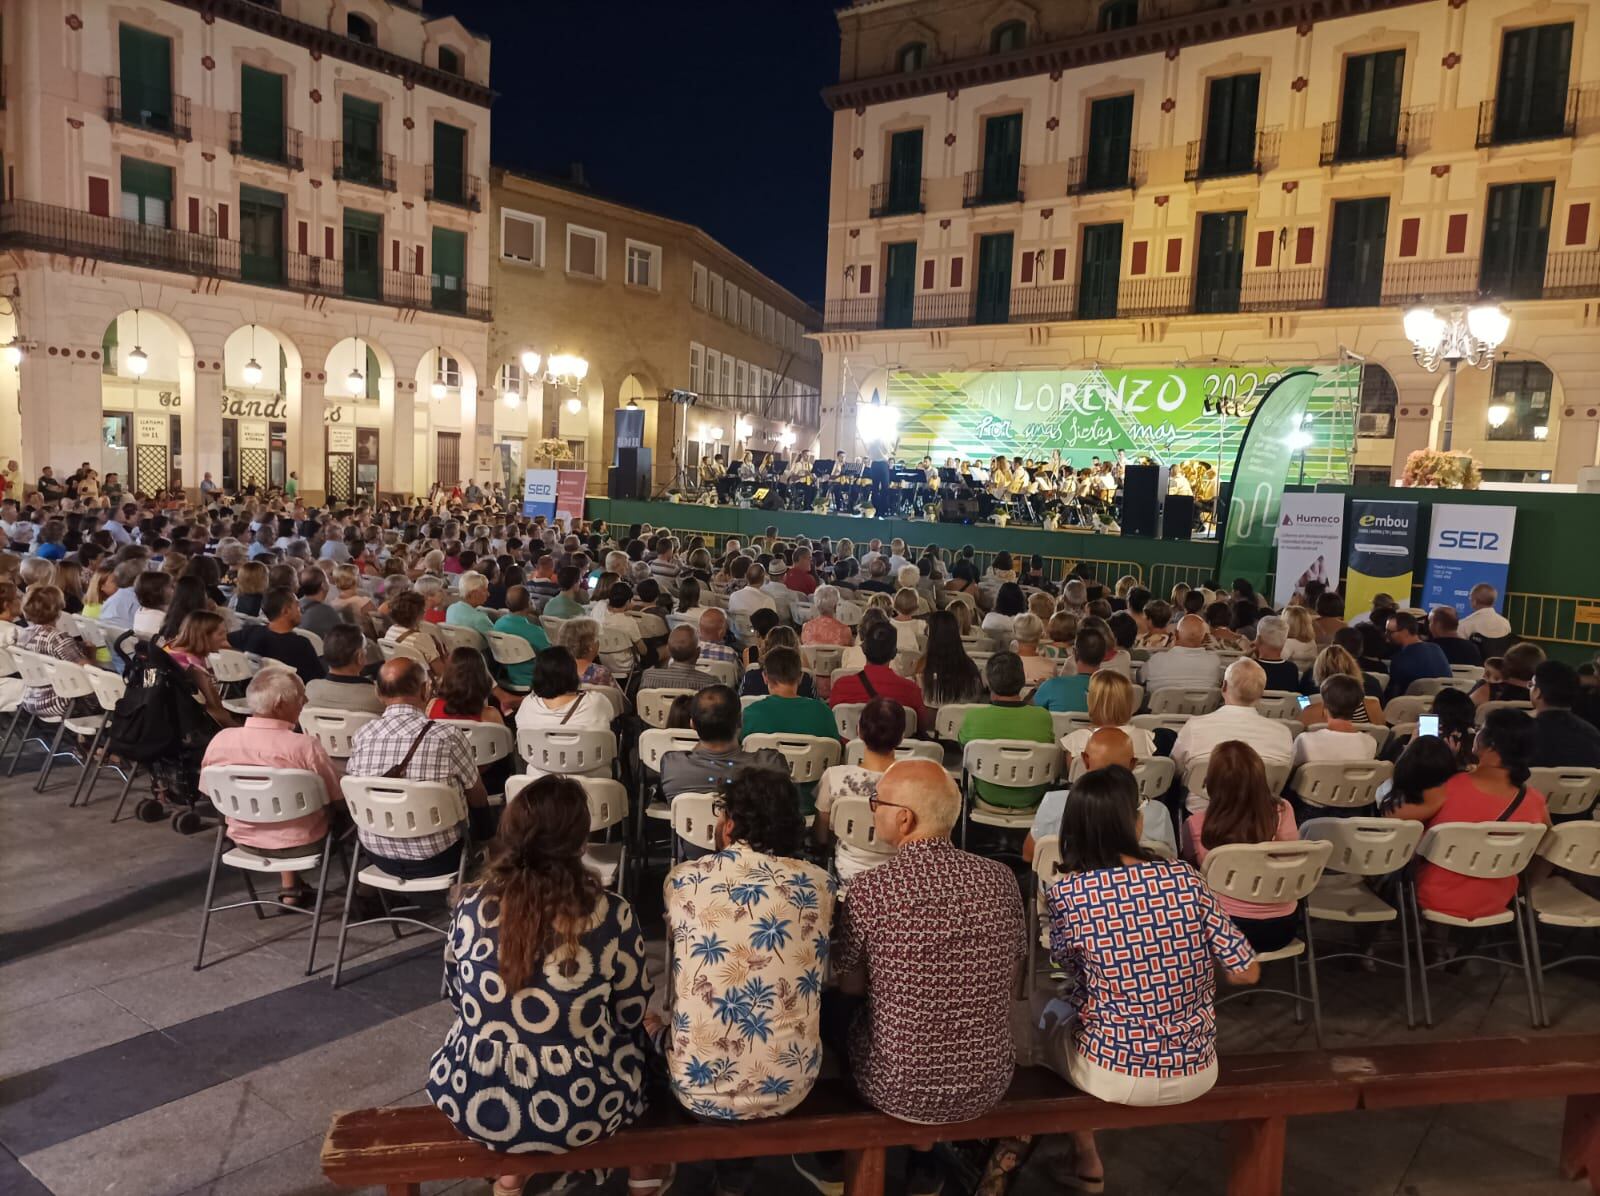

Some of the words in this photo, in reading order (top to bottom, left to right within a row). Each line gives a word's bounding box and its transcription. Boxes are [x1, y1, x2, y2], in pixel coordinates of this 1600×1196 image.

[1014, 374, 1187, 416] LORENZO
[528, 484, 551, 496] SER
[1296, 514, 1340, 524] Humeco
[1359, 514, 1409, 528] embou
[1439, 530, 1499, 551] SER
